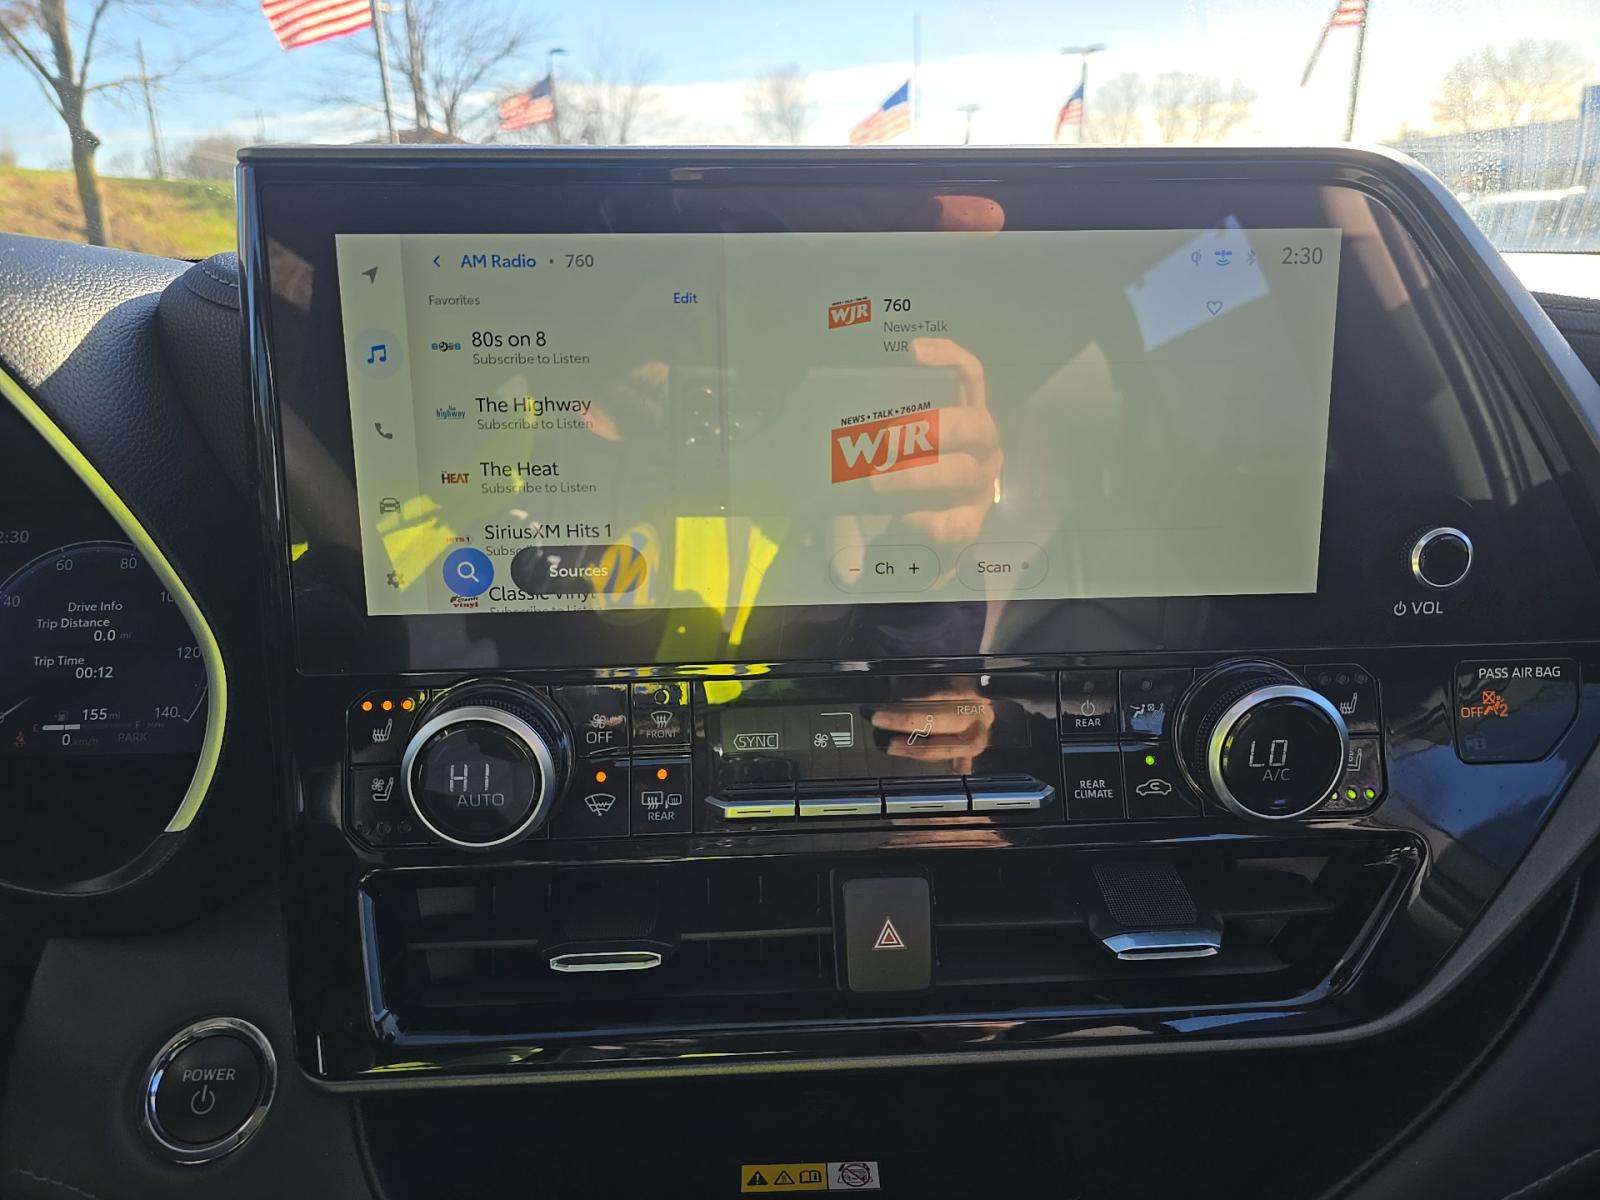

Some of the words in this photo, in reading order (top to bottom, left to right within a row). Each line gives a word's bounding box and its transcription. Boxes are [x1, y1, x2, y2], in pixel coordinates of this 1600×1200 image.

[461, 254, 487, 268] AM
[491, 253, 537, 268] Radio
[565, 254, 594, 268] 760
[1280, 247, 1323, 265] 2:30
[428, 294, 481, 306] Favorites
[673, 291, 699, 305] Edit
[883, 298, 911, 312] 760
[829, 303, 869, 325] WJR
[883, 320, 948, 333] News+Talk
[471, 331, 503, 347] 80s
[508, 333, 531, 347] on
[536, 331, 547, 347] 8
[883, 340, 909, 352] WJR
[472, 353, 534, 365] Subscribe
[537, 354, 550, 365] to
[553, 352, 590, 365] Listen
[475, 396, 508, 412] The
[514, 395, 592, 416] Highway
[436, 408, 466, 420] highway
[841, 414, 866, 427] NEWS
[873, 408, 893, 420] TALK
[901, 404, 917, 415] 760
[917, 401, 931, 411] AM
[477, 418, 538, 430] Subscribe
[541, 419, 554, 430] to
[557, 418, 593, 430] Listen
[836, 420, 934, 472] WJR
[480, 461, 512, 477] The
[517, 461, 560, 477] Heat
[441, 472, 470, 484] HEAT
[481, 482, 542, 494] Subscribe
[545, 483, 558, 494] to
[561, 482, 597, 494] Listen
[484, 524, 560, 540] SiriusXM
[566, 524, 600, 538] Hits
[604, 523, 613, 538] 1
[56, 559, 73, 571] 60
[120, 557, 137, 569] 80
[874, 562, 894, 575] Ch
[977, 561, 1011, 574] Scan
[549, 564, 609, 579] Sources
[3, 595, 21, 608] 40
[68, 602, 97, 612] Drive
[100, 601, 123, 611] Info
[1411, 601, 1444, 615] VOL
[37, 619, 57, 630] Trip
[61, 618, 111, 628] Distance
[94, 630, 116, 642] 0.0
[176, 646, 201, 659] 120
[34, 656, 54, 667] Trip
[58, 655, 85, 666] Time
[75, 667, 114, 679] 00:12
[1478, 667, 1509, 679] PASS
[1512, 667, 1533, 678] AIR
[1536, 666, 1561, 678] BAG
[82, 708, 108, 721] 155
[154, 706, 178, 719] 140
[956, 705, 986, 716] REAR
[1460, 707, 1484, 718] OFF
[1499, 703, 1509, 717] 2
[1075, 718, 1102, 728] REAR
[62, 733, 71, 746] 0
[118, 732, 149, 743] PARK
[586, 731, 613, 744] OFF
[646, 730, 676, 739] FRONT
[738, 735, 776, 748] SYNC
[1262, 768, 1292, 782] A/C
[1079, 780, 1106, 790] REAR
[456, 793, 505, 807] AUTO
[1074, 789, 1114, 799] CLIMATE
[647, 811, 675, 821] REAR
[182, 1068, 236, 1083] POWER
